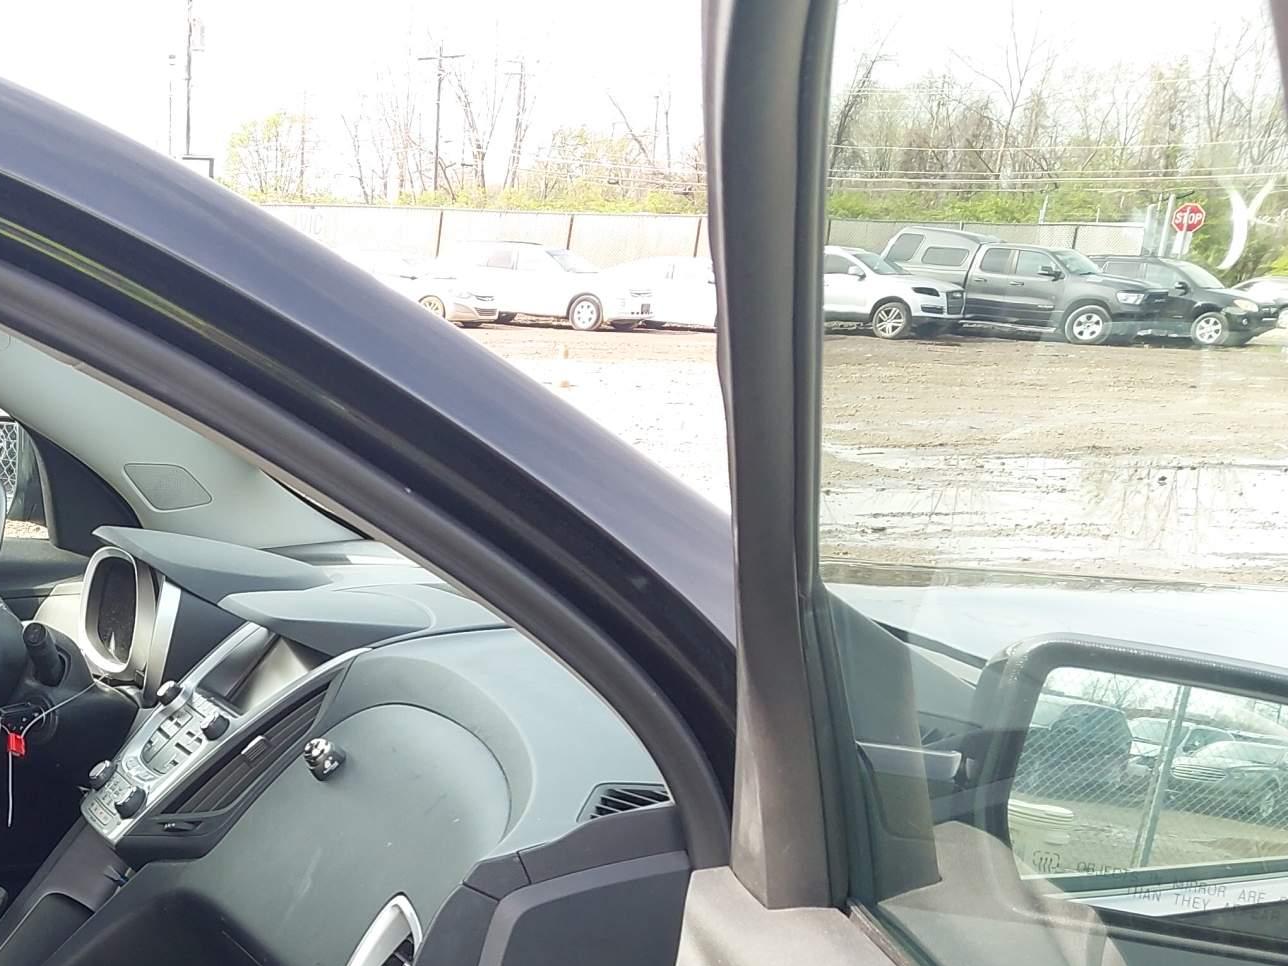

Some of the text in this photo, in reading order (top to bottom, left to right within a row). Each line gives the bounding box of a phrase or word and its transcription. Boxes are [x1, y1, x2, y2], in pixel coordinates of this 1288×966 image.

[1174, 211, 1203, 225] STOP
[1173, 893, 1210, 912] THEY
[1238, 888, 1267, 904] ARE
